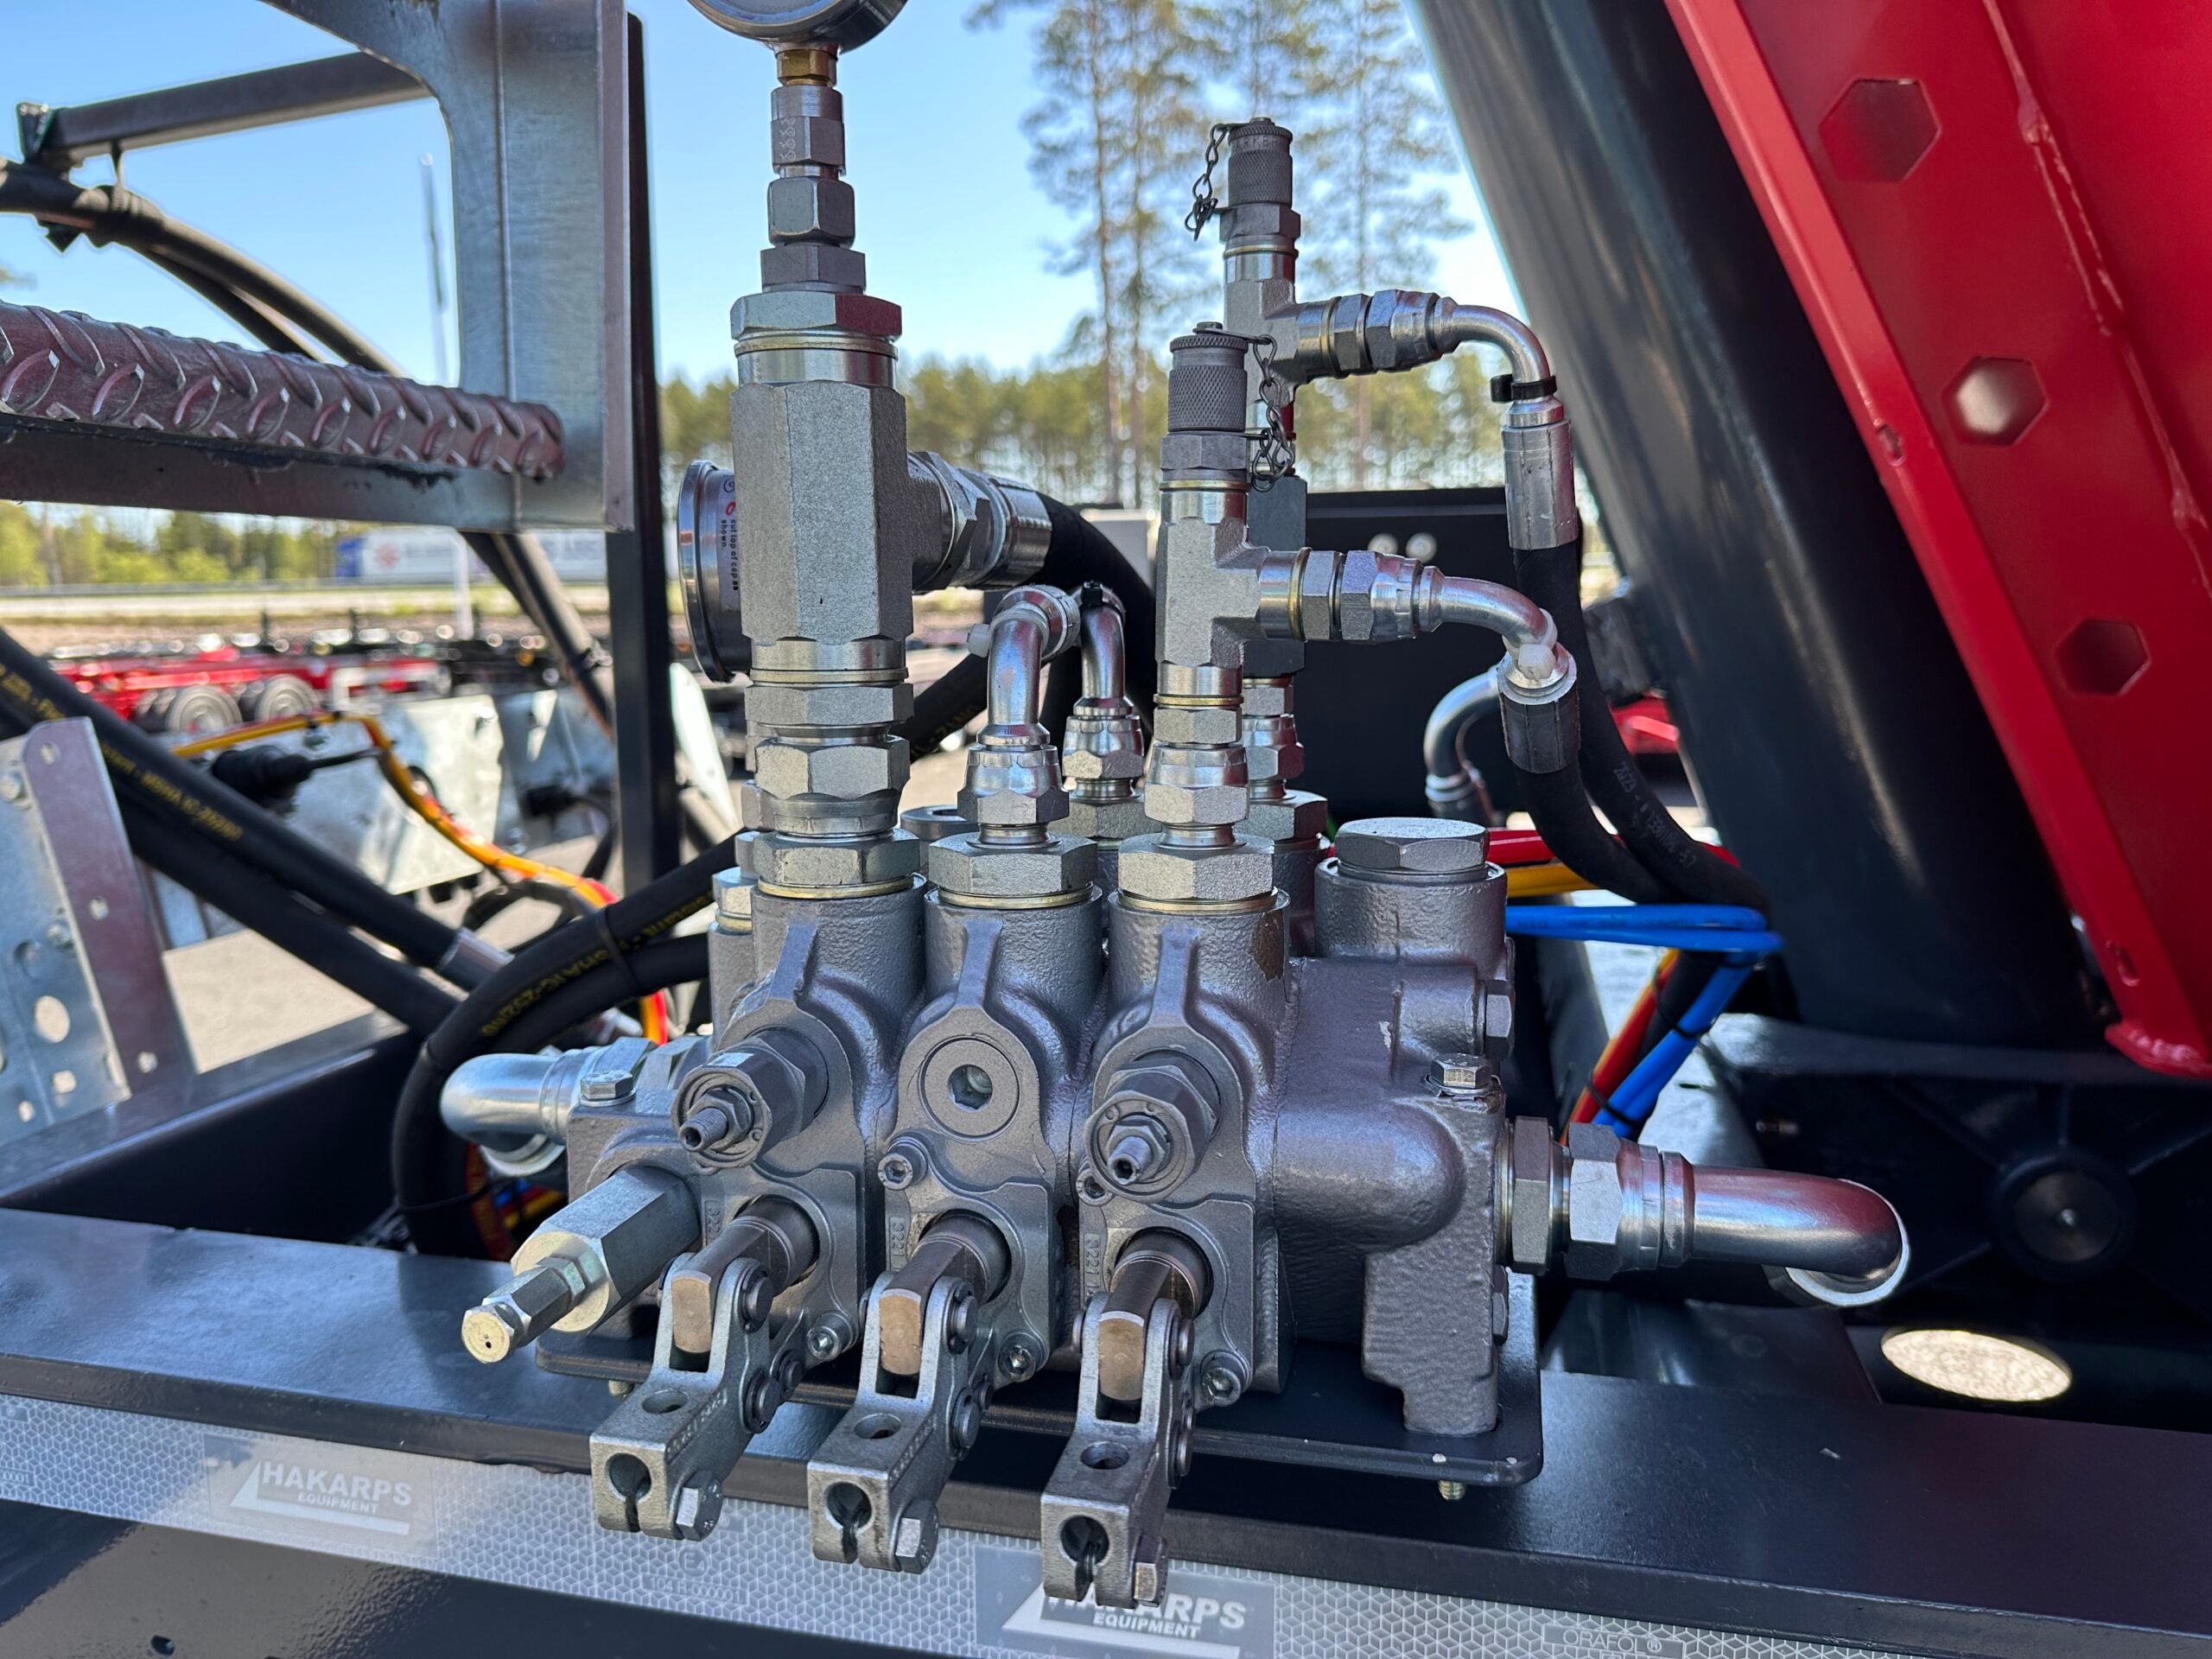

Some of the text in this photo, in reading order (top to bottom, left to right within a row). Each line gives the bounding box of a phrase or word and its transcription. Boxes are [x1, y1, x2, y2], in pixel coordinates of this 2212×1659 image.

[730, 550, 737, 560] of
[262, 1461, 413, 1506] HAKARPS
[297, 1491, 379, 1514] EQUIPMENT
[1092, 1611, 1201, 1639] EQUIPMENT
